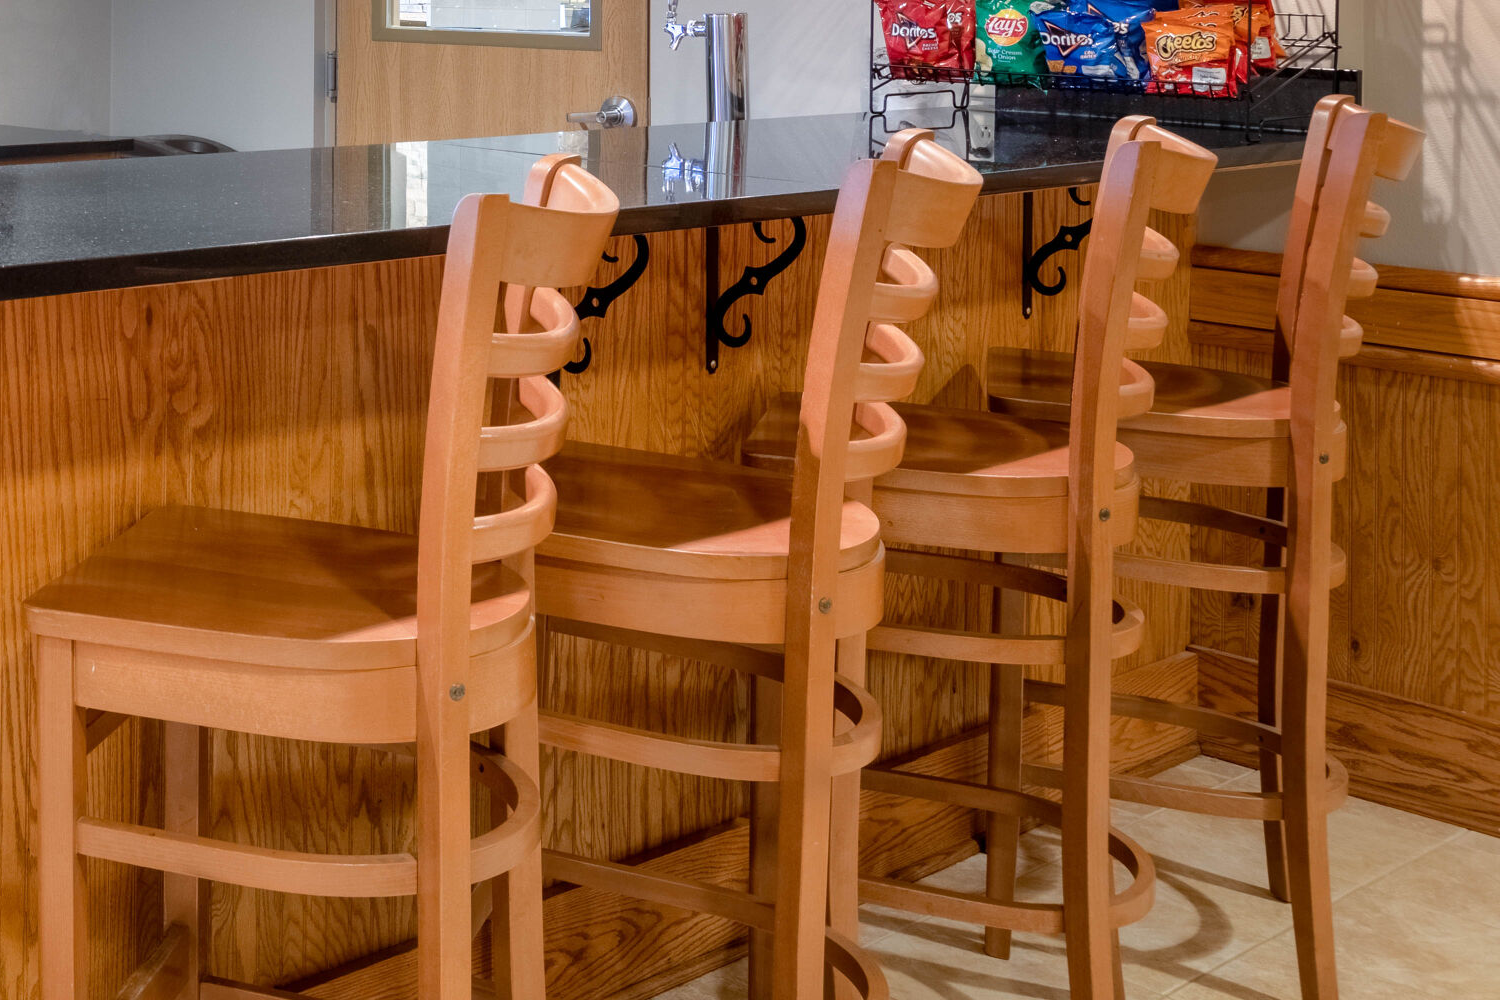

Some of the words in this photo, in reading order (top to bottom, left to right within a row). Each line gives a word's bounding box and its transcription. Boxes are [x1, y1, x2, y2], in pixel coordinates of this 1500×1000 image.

[891, 23, 937, 39] Doritos
[987, 15, 1026, 37] Lay's
[1039, 31, 1094, 46] Doritos
[1156, 31, 1216, 60] Cheetos
